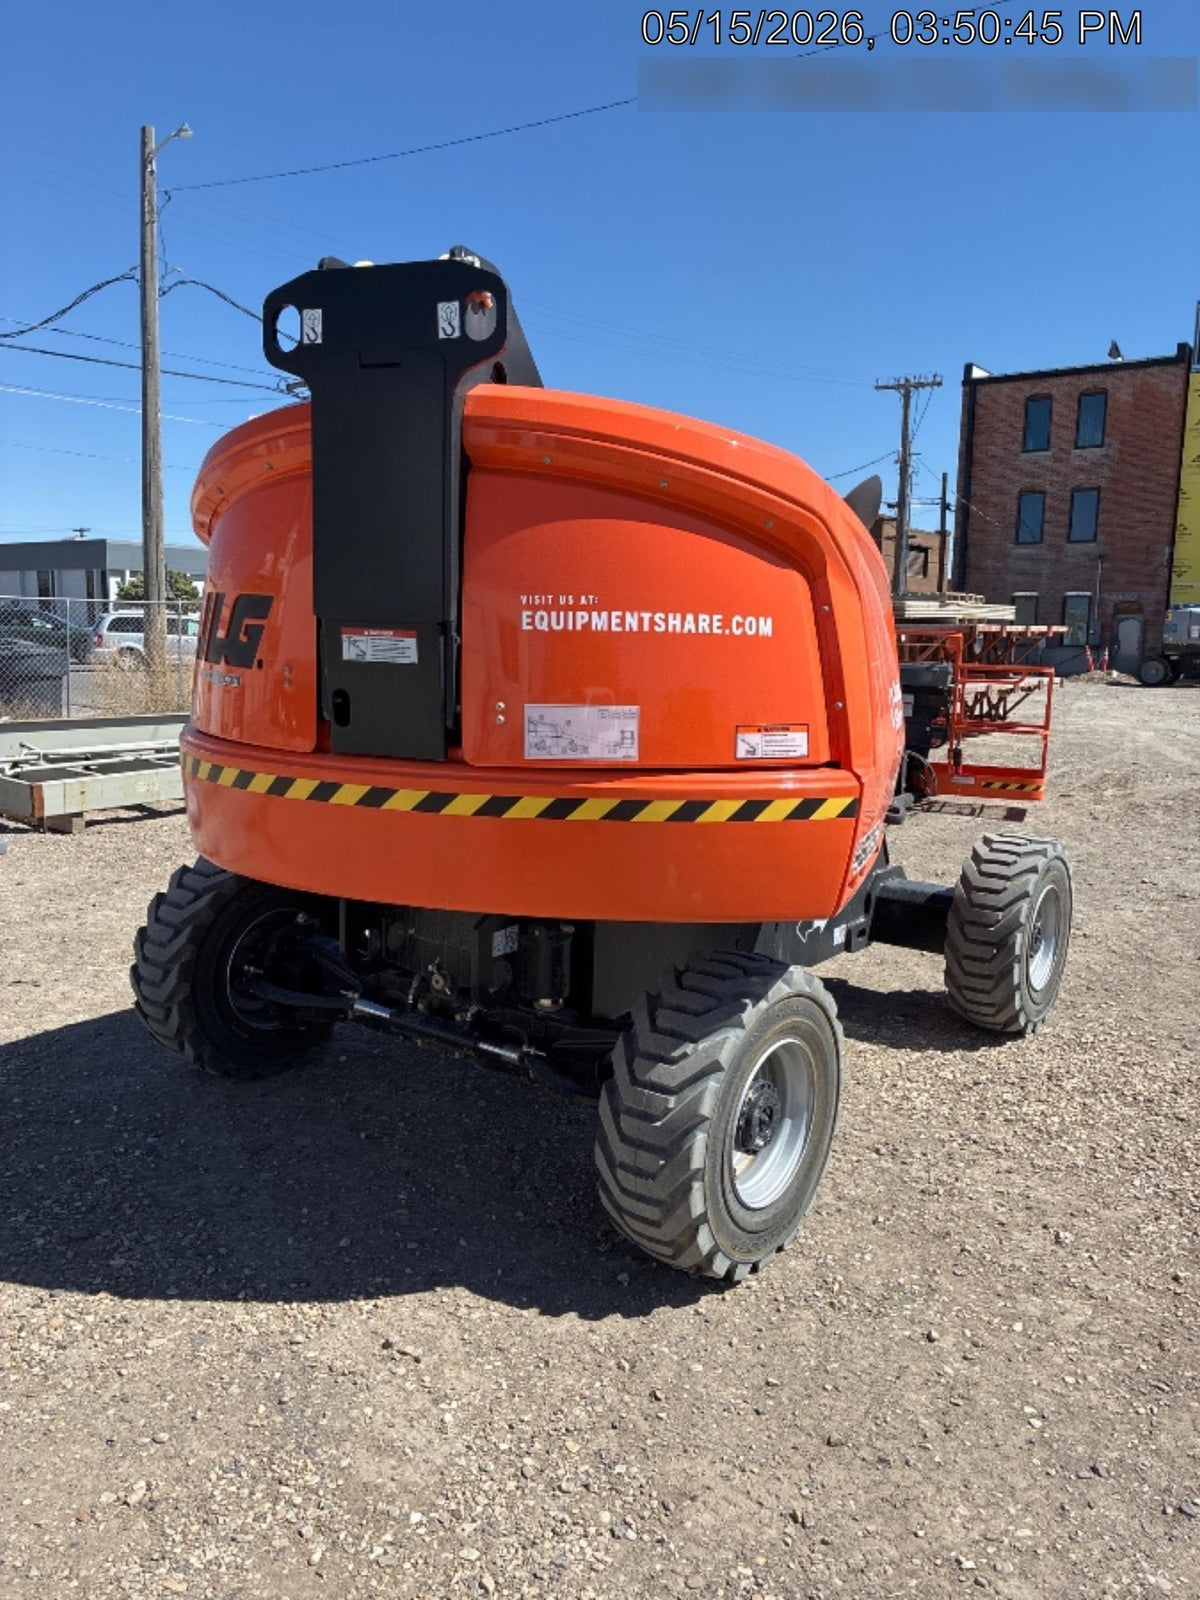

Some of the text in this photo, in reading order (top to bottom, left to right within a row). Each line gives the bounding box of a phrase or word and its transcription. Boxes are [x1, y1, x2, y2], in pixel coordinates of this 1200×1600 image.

[520, 594, 599, 606] VISIT US AT:
[521, 610, 773, 638] EQUIPMENTSHARE.COM
